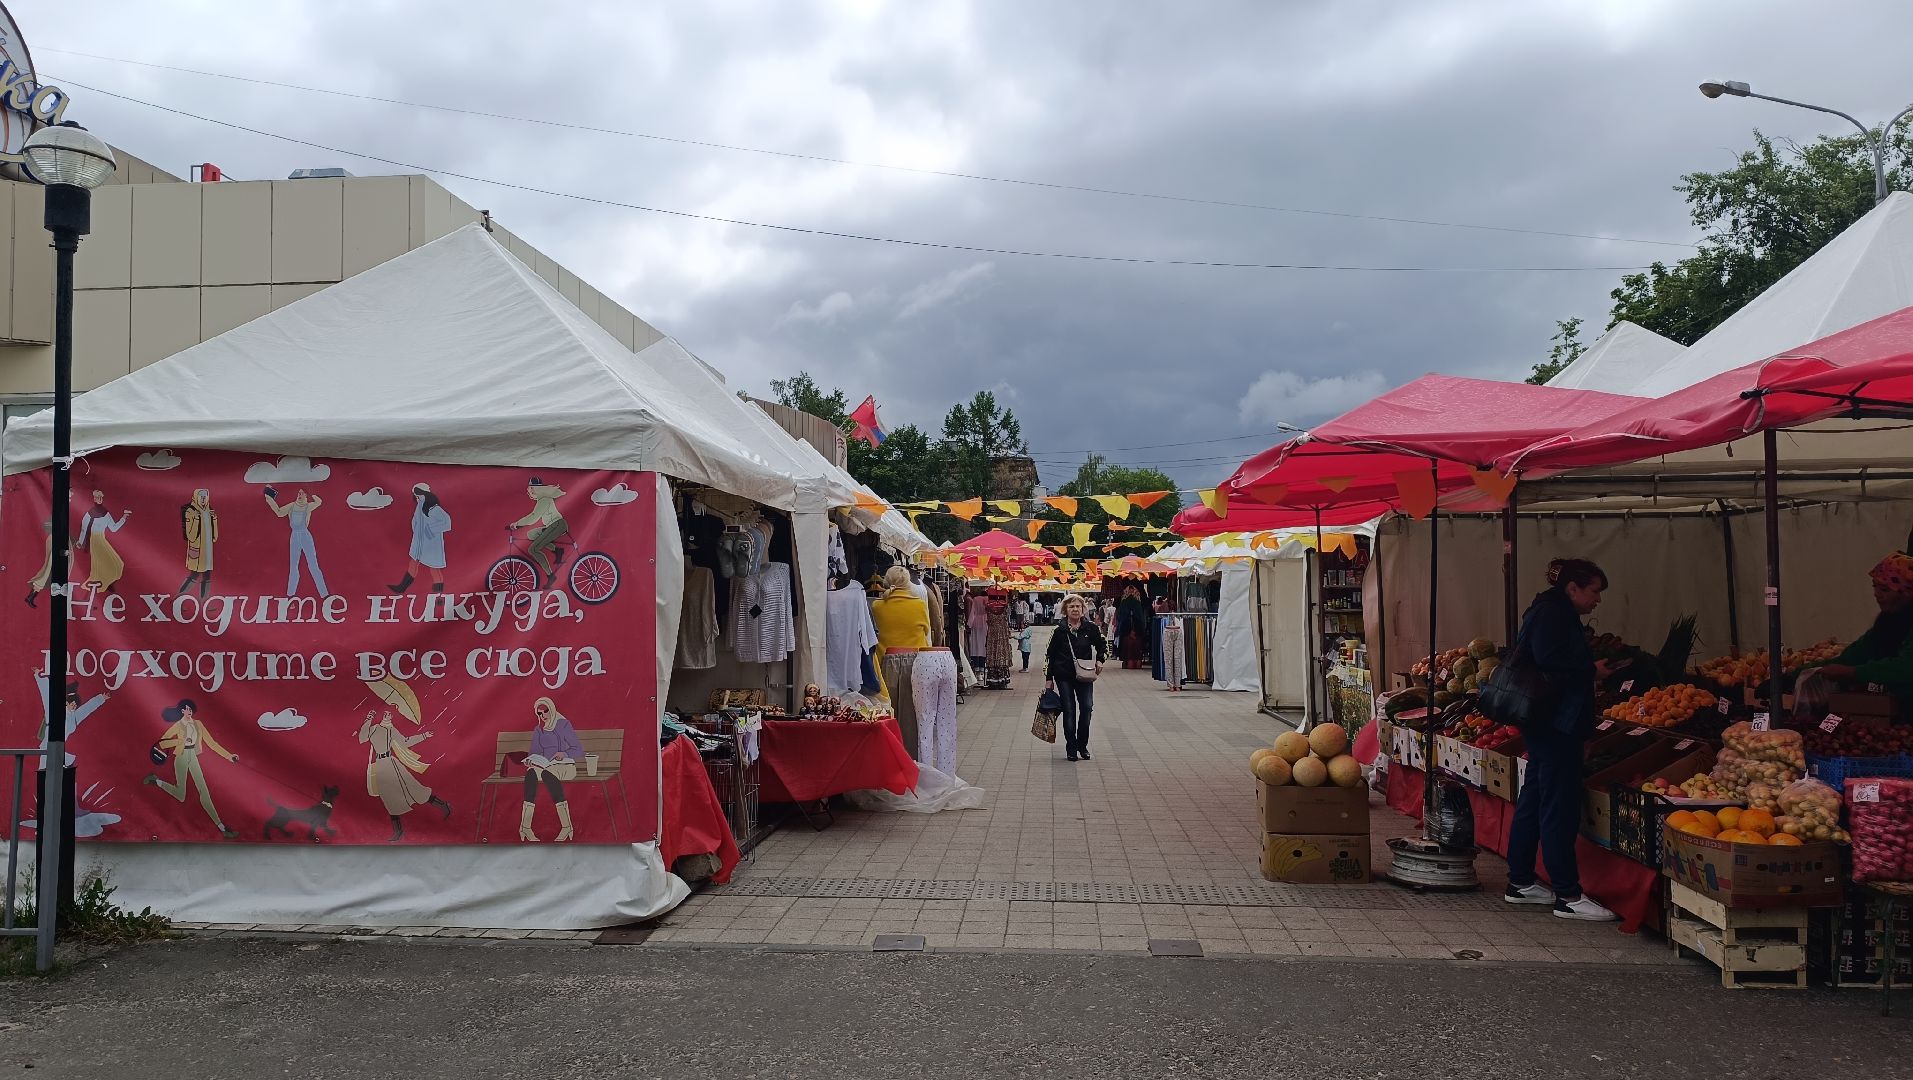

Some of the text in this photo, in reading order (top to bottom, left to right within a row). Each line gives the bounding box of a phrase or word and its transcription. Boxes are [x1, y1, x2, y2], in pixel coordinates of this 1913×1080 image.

[66, 581, 584, 637] Не ходите никуда,
[355, 649, 447, 681] все
[465, 646, 607, 690] сюда
